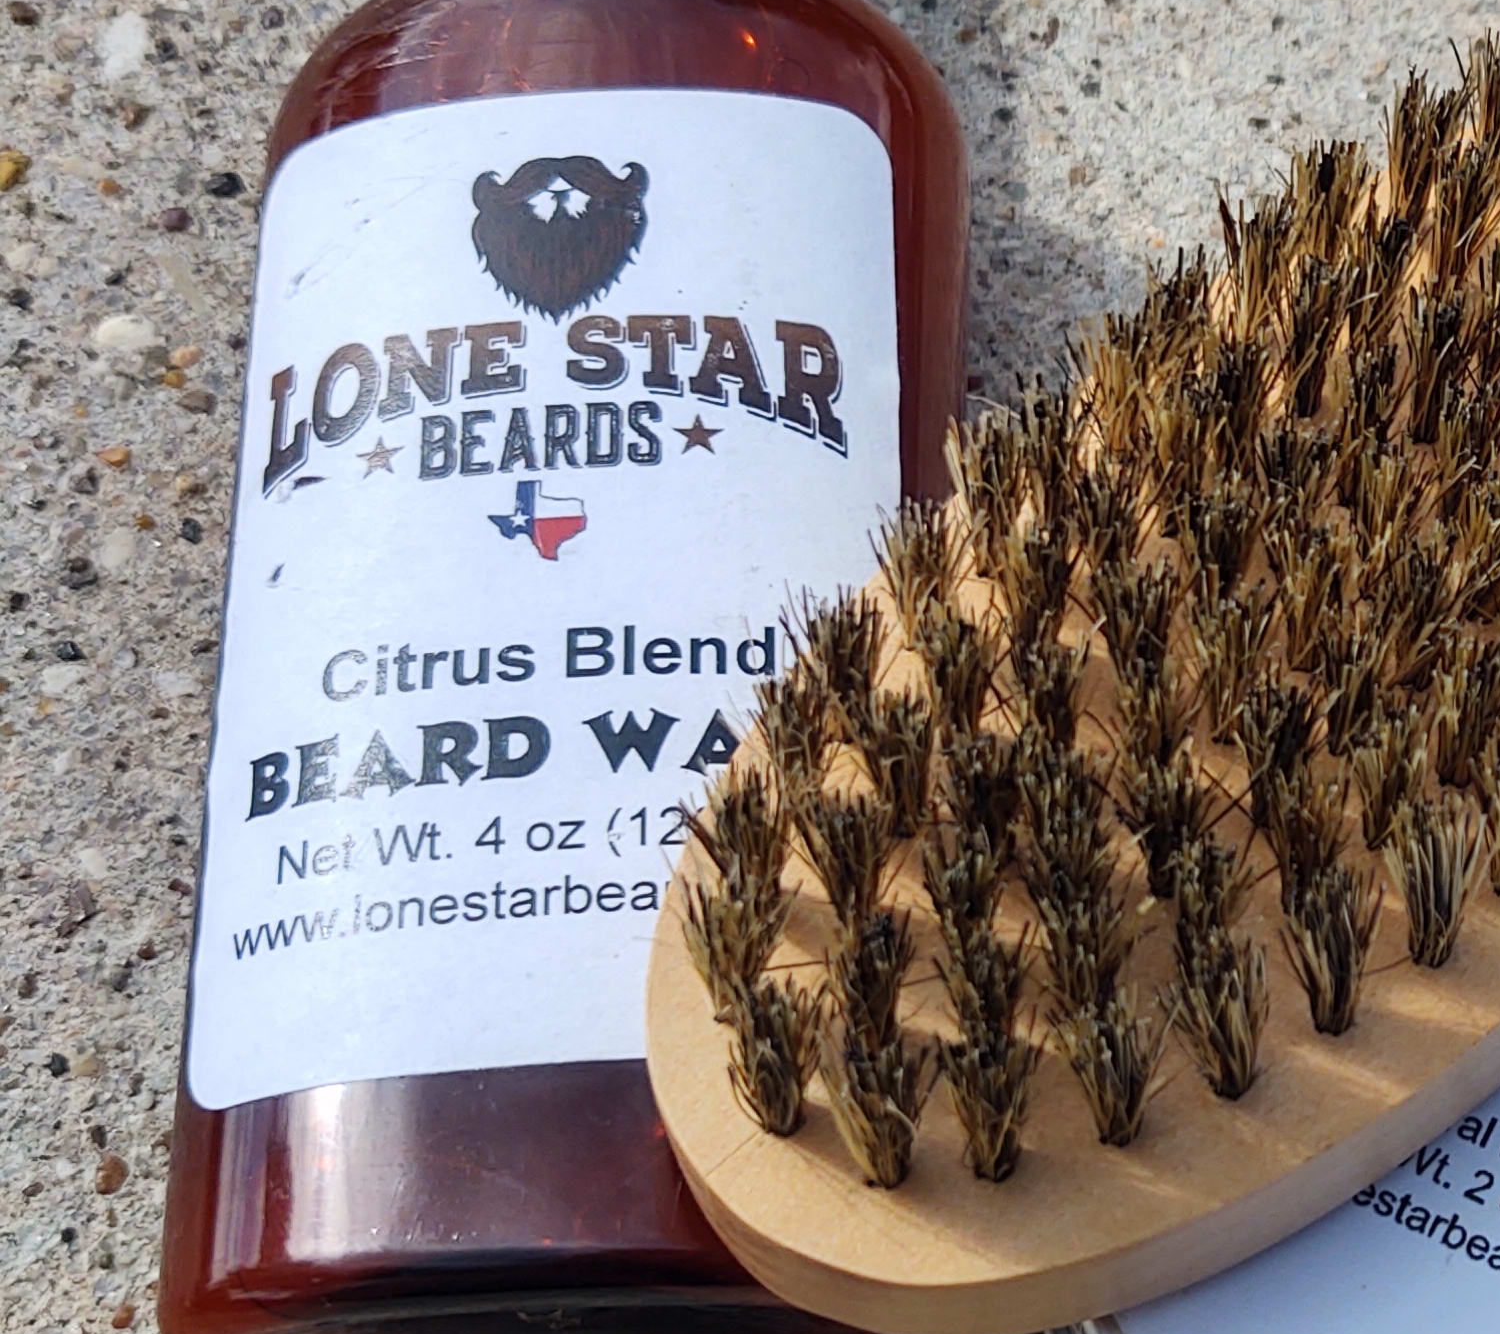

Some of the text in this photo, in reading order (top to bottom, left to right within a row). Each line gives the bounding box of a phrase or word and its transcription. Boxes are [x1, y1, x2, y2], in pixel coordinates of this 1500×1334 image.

[263, 314, 848, 499] LONE STAR
[418, 400, 663, 482] BEARDS
[321, 624, 776, 703] Citrus Blend
[245, 707, 741, 823] BEARD WA
[276, 805, 703, 885] Net Wt. 4 oz (12
[233, 874, 669, 960] www.lonestarbea
[1463, 1169, 1495, 1205] 2
